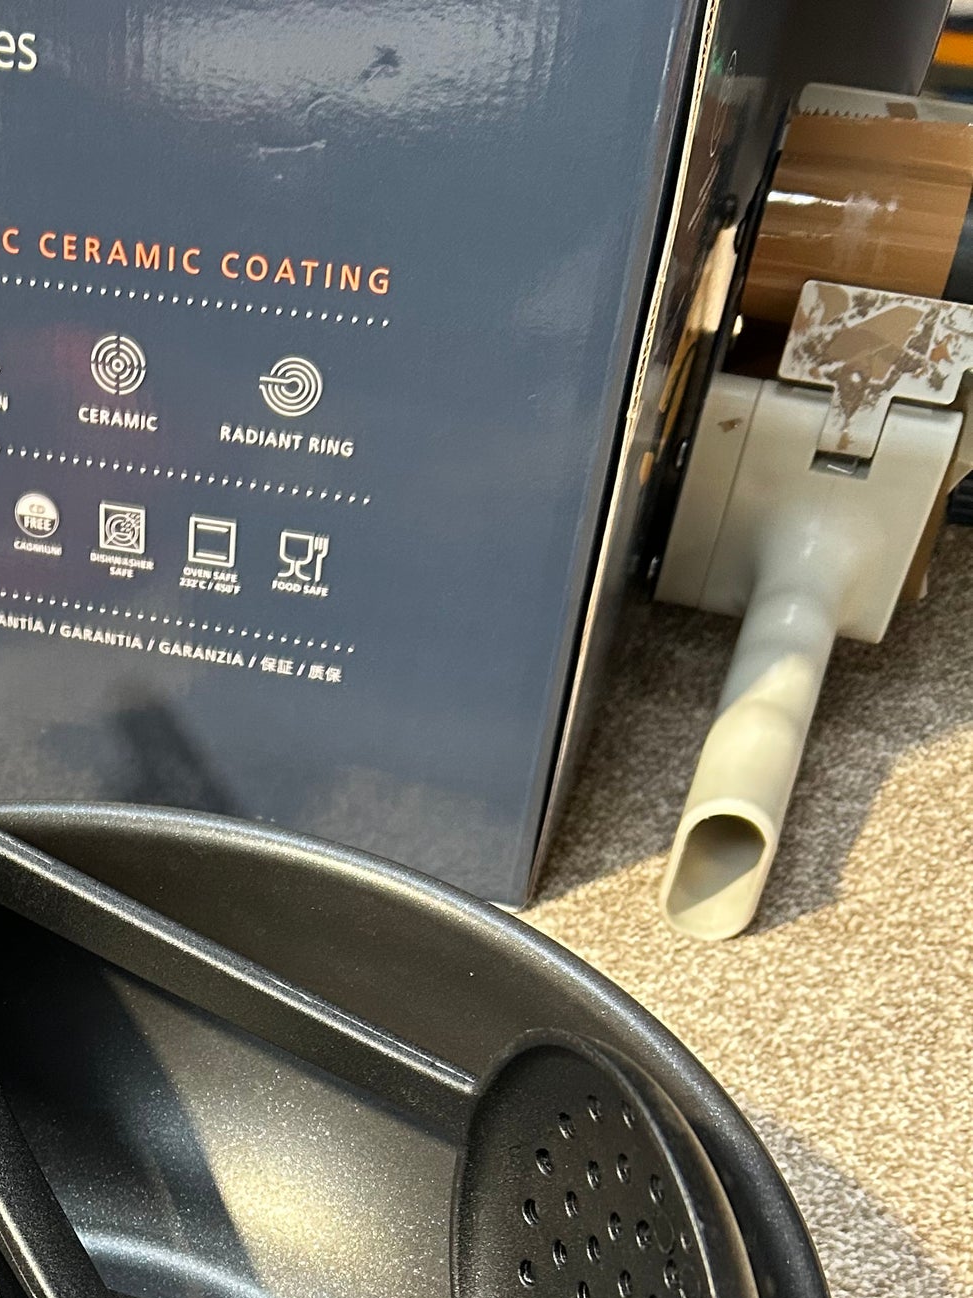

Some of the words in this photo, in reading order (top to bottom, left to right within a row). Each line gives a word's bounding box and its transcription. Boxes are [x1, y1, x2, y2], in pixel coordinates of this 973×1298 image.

[38, 231, 201, 275] CERAMIC
[220, 251, 391, 295] COATING
[78, 406, 159, 432] CERAMIC
[219, 424, 302, 451] RADIANT
[308, 436, 355, 458] RING
[23, 516, 53, 532] FREE
[90, 552, 155, 571] DISHWASHER
[109, 566, 135, 579] SAFE
[183, 567, 211, 580] OVEN
[212, 570, 239, 584] SAFE
[272, 580, 301, 594] FOOD
[303, 584, 330, 598] SAFE
[59, 623, 144, 651] GARANTIA
[158, 640, 245, 668] GARANZIA
